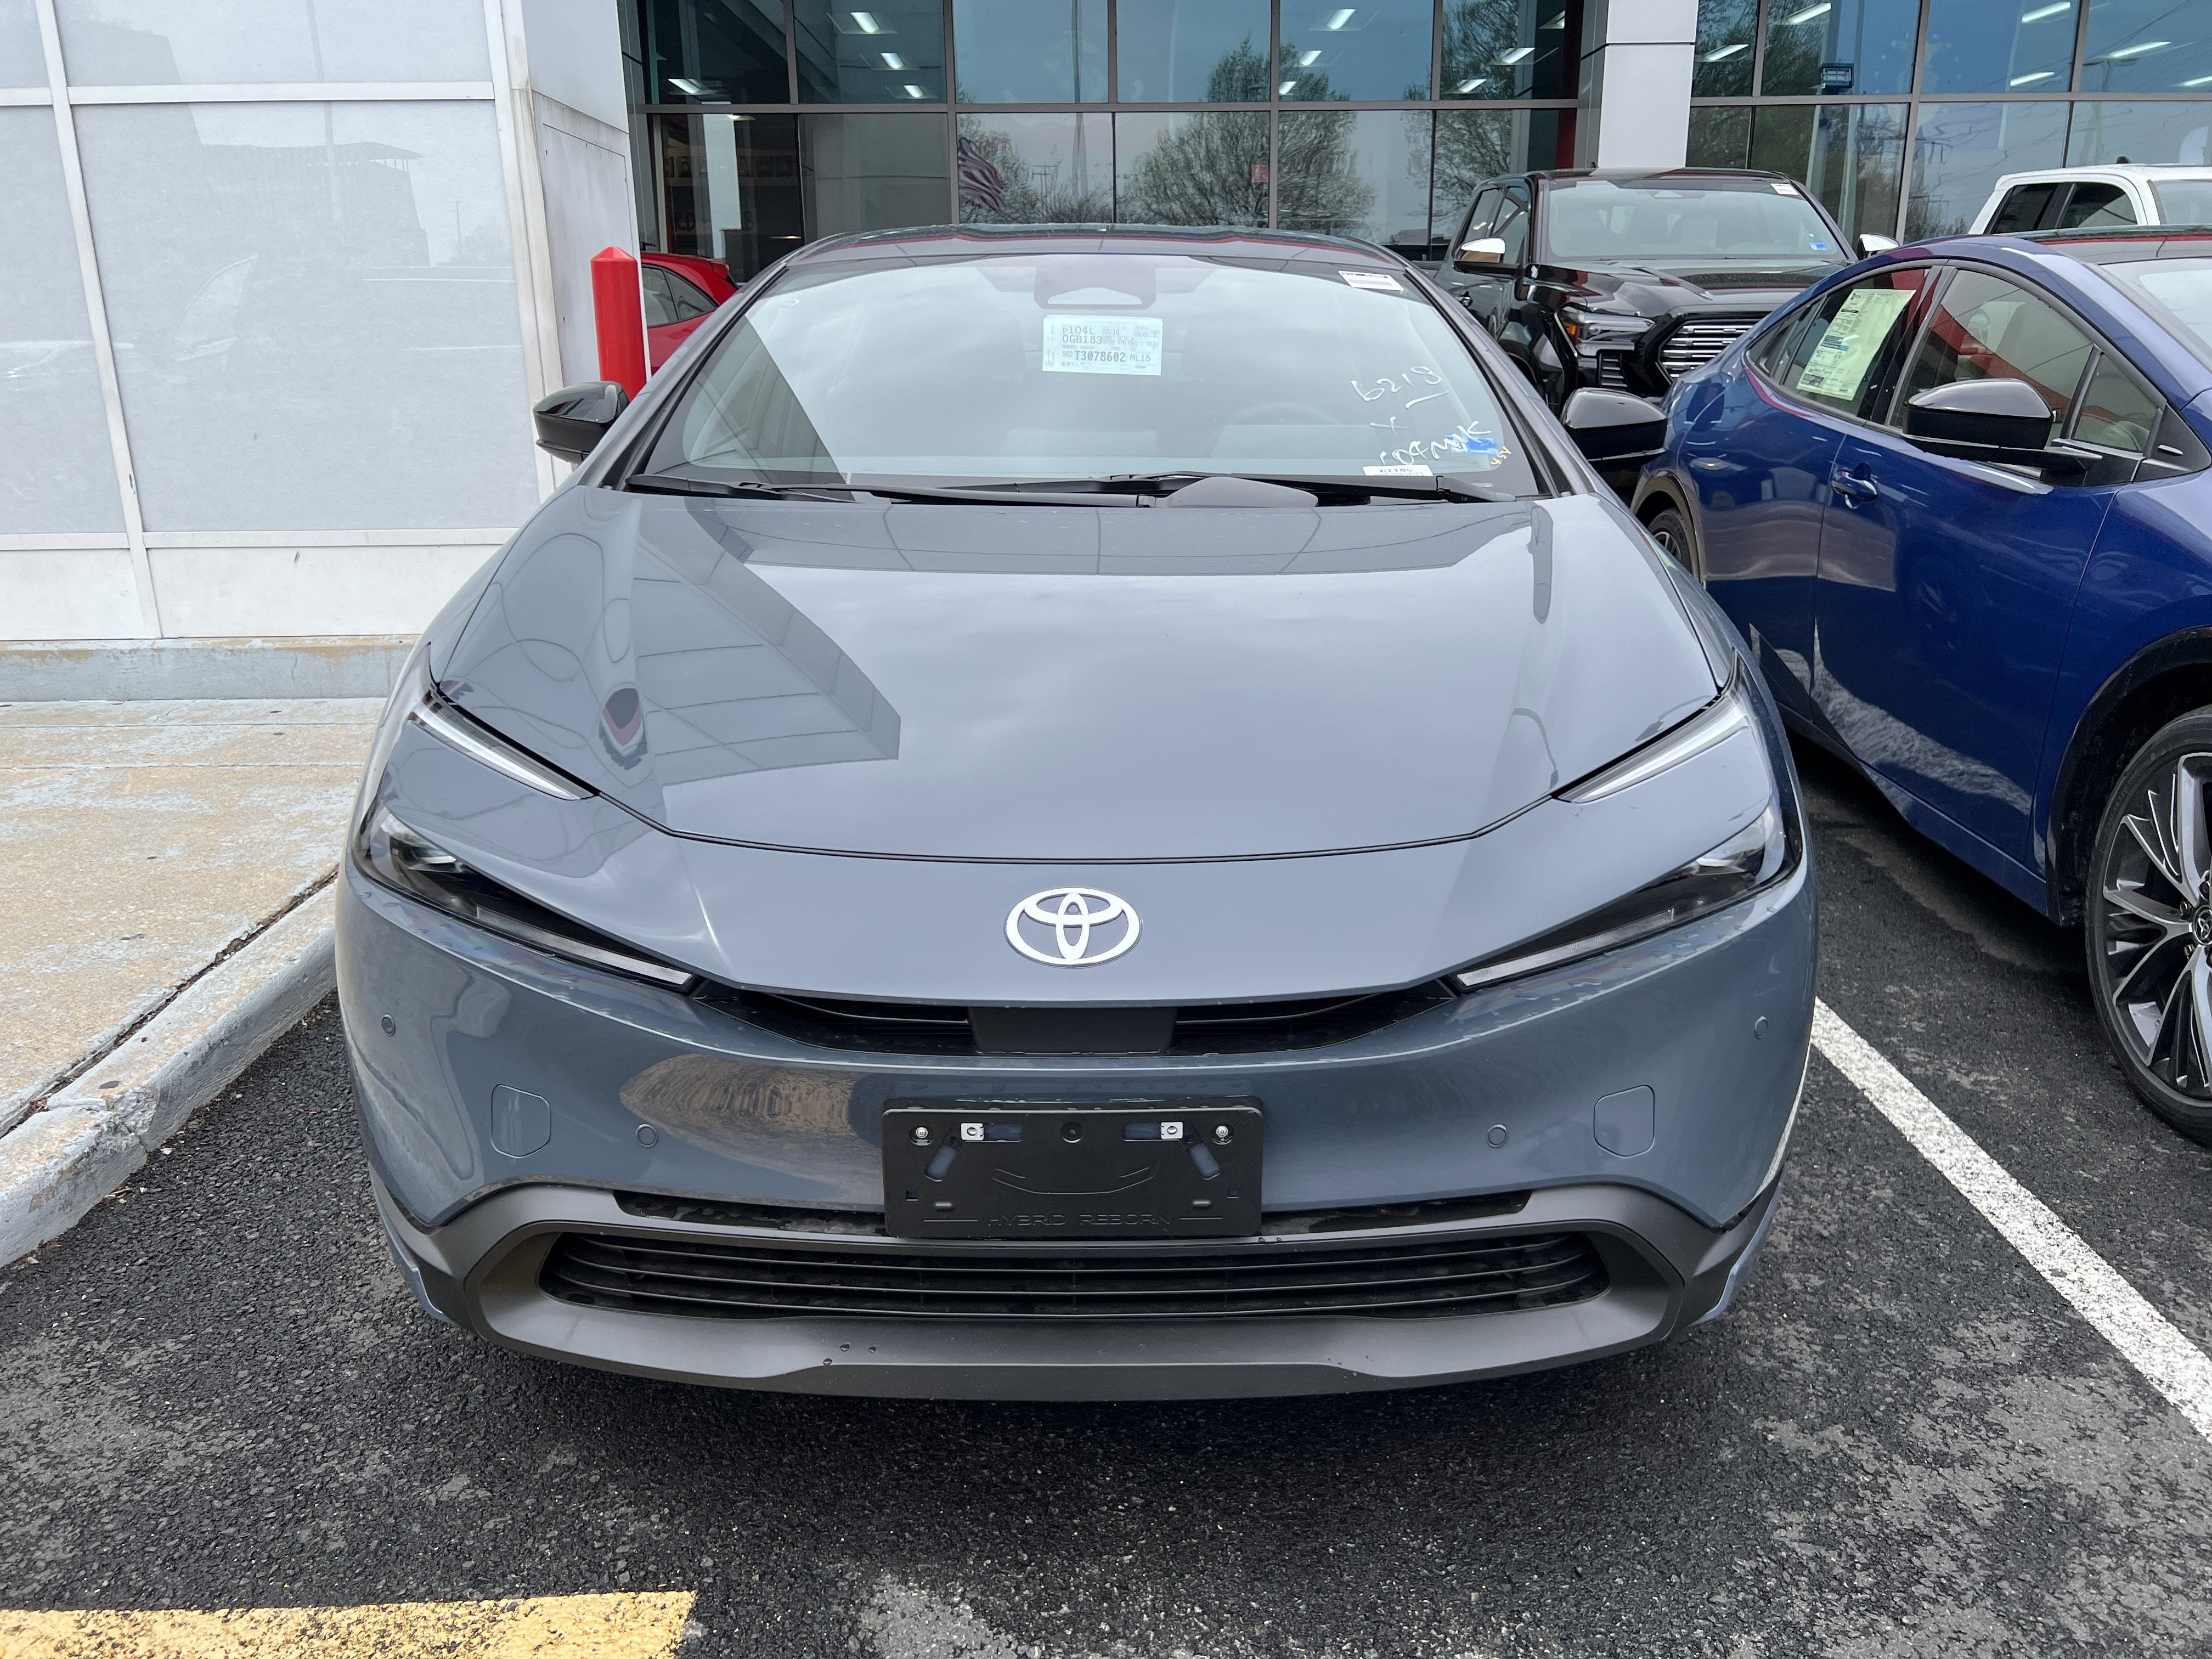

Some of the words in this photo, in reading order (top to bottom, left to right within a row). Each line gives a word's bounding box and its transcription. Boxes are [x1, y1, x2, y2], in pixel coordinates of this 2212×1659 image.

[1075, 351, 1126, 363] T3078602
[1130, 354, 1150, 362] ML15
[987, 1214, 1066, 1227] HYBRID
[1079, 1213, 1171, 1226] REBORN
